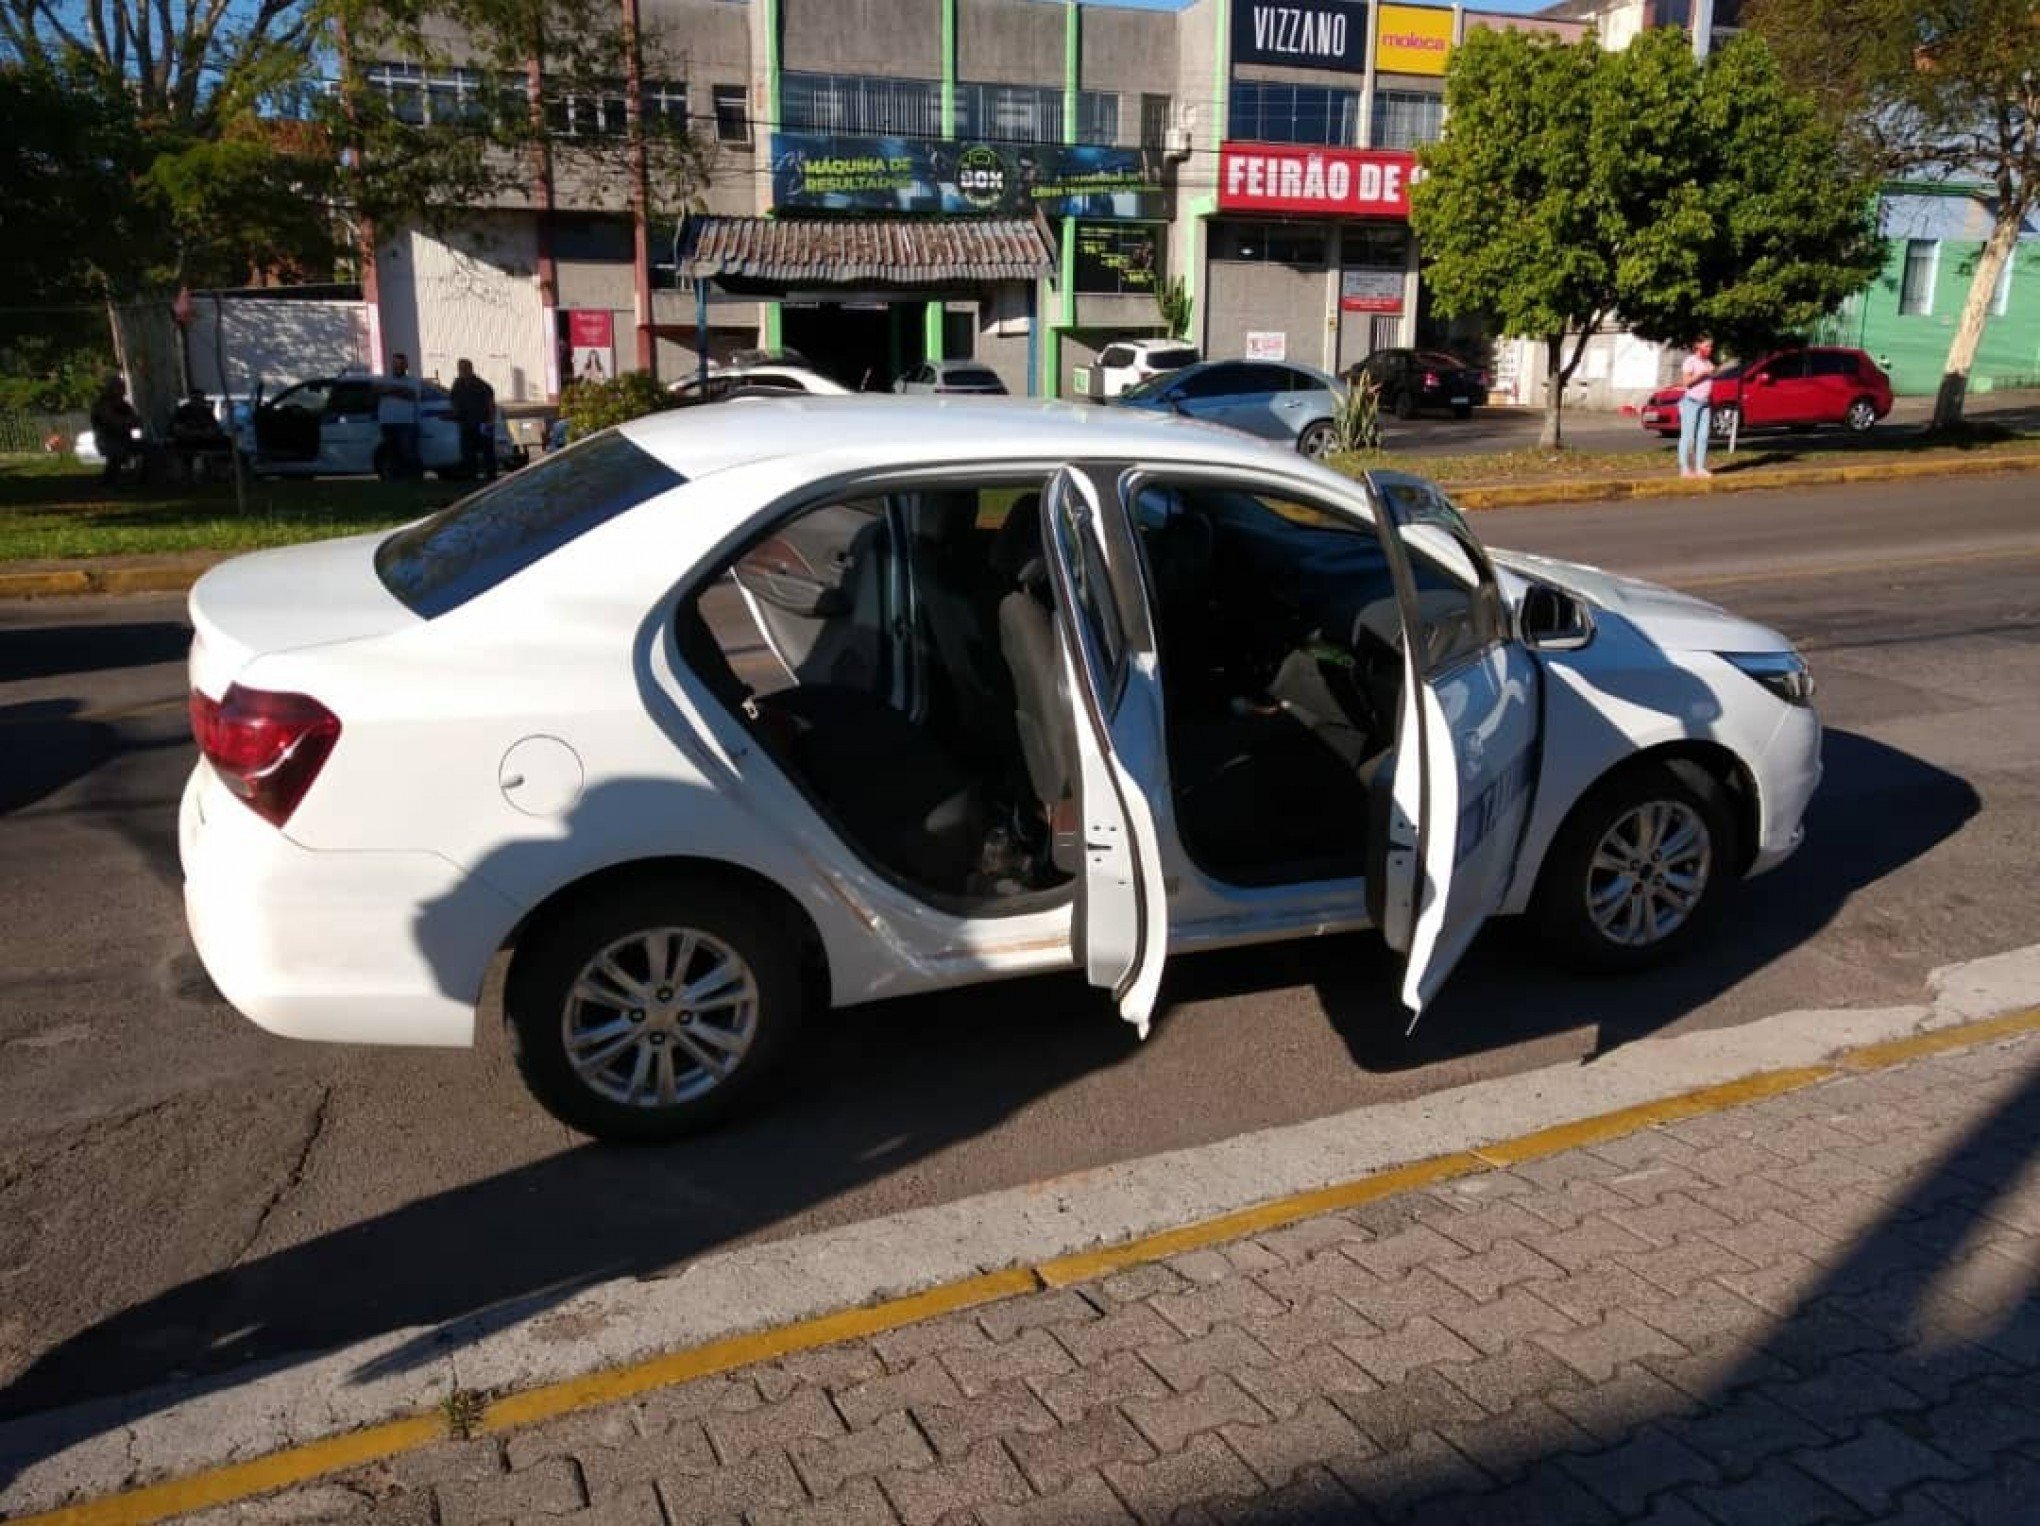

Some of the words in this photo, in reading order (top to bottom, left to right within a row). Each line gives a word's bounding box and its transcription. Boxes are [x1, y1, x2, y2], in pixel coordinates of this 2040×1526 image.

[1253, 5, 1346, 57] VIZZANO
[889, 156, 913, 171] DE
[1227, 152, 1350, 201] FEIRÃO
[1358, 163, 1402, 203] DE
